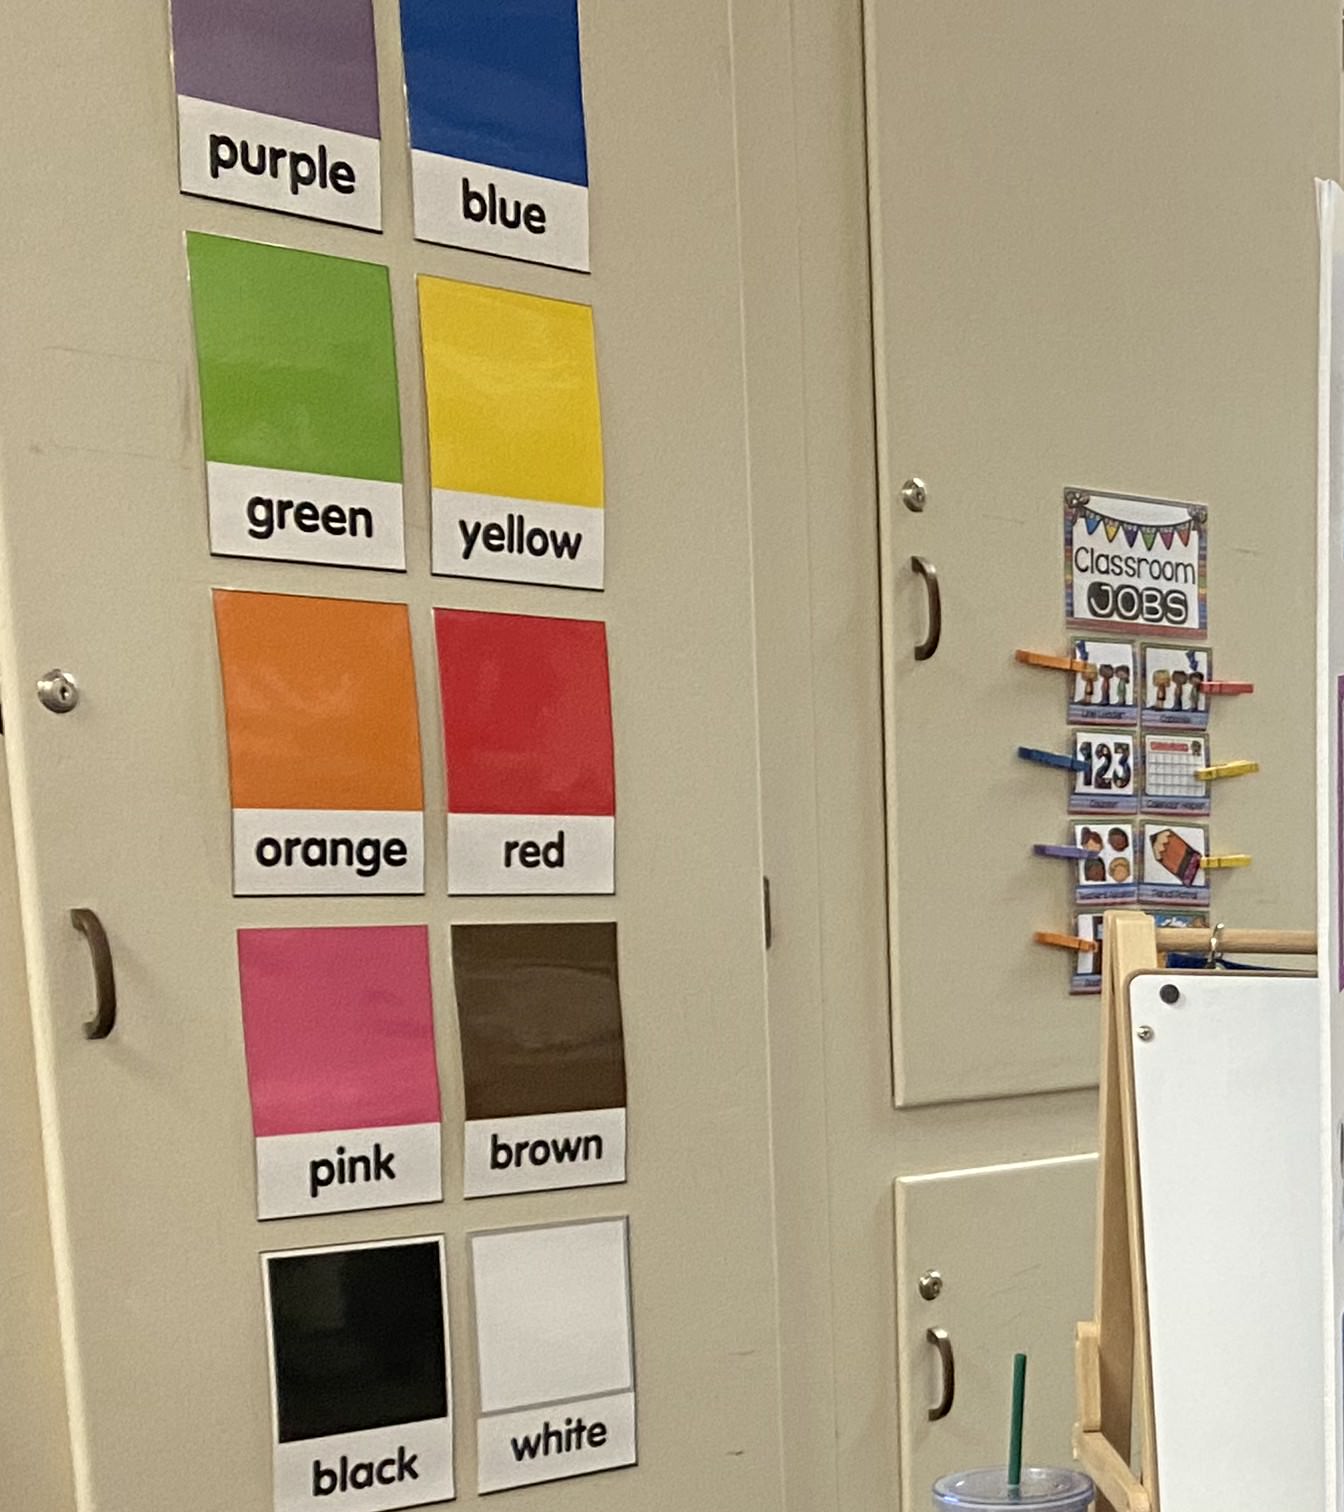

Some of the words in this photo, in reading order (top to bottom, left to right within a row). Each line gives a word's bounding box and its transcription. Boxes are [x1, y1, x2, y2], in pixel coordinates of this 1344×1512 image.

[209, 131, 356, 196] purple
[462, 178, 547, 235] blue
[247, 496, 374, 541] green
[459, 515, 583, 561] yellow
[1074, 546, 1196, 584] Classroom
[1088, 583, 1188, 623] JOBS
[255, 833, 408, 877] orange
[503, 832, 566, 869] red
[310, 1144, 396, 1197] pink
[490, 1132, 603, 1171] brown
[511, 1418, 608, 1463] white
[312, 1447, 420, 1498] black
